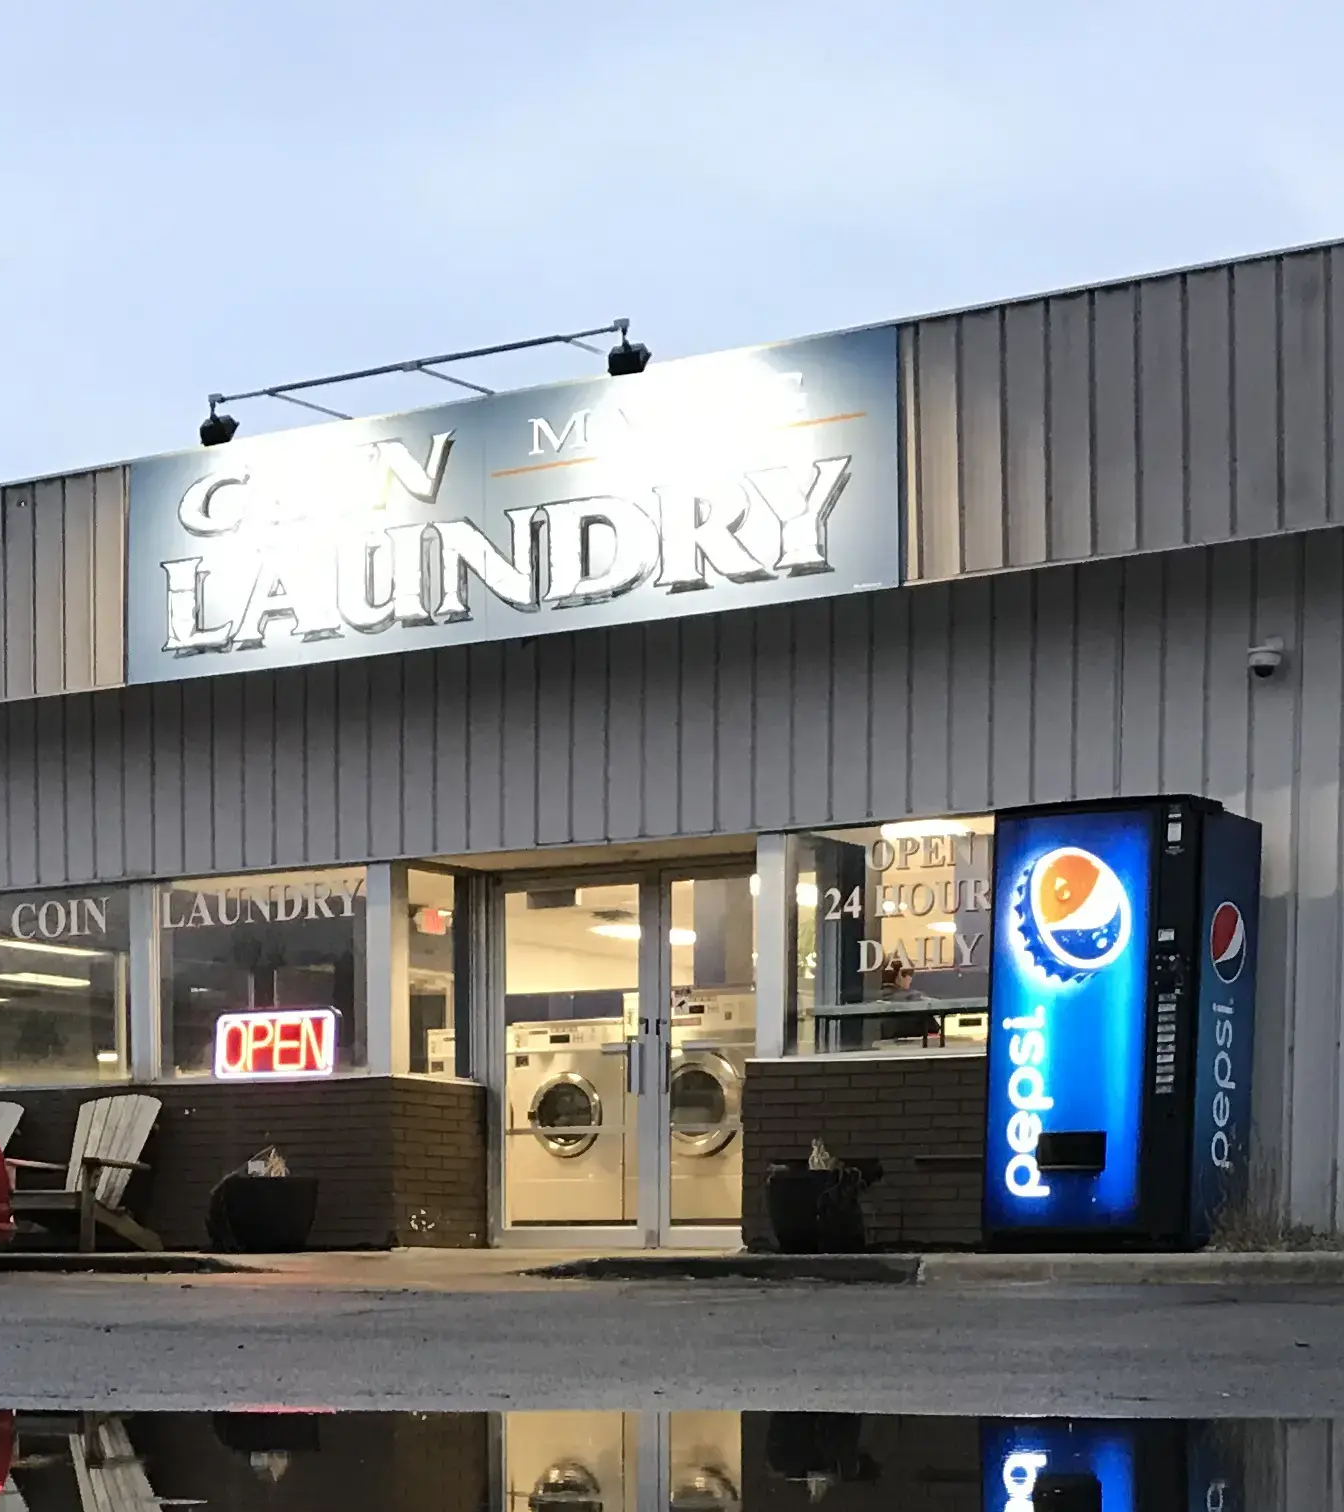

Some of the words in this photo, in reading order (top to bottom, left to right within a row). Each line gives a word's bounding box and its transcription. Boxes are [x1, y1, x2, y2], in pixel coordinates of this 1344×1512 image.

[160, 454, 853, 658] LAUNDRY
[865, 831, 976, 872] OPEN
[11, 896, 109, 941] COIN
[161, 877, 366, 930] LAUNDRY
[824, 885, 862, 921] 24
[857, 932, 984, 973] DAILY
[224, 1016, 329, 1072] OPEN
[1002, 1004, 1054, 1197] pepsi
[1211, 998, 1236, 1169] pepsi
